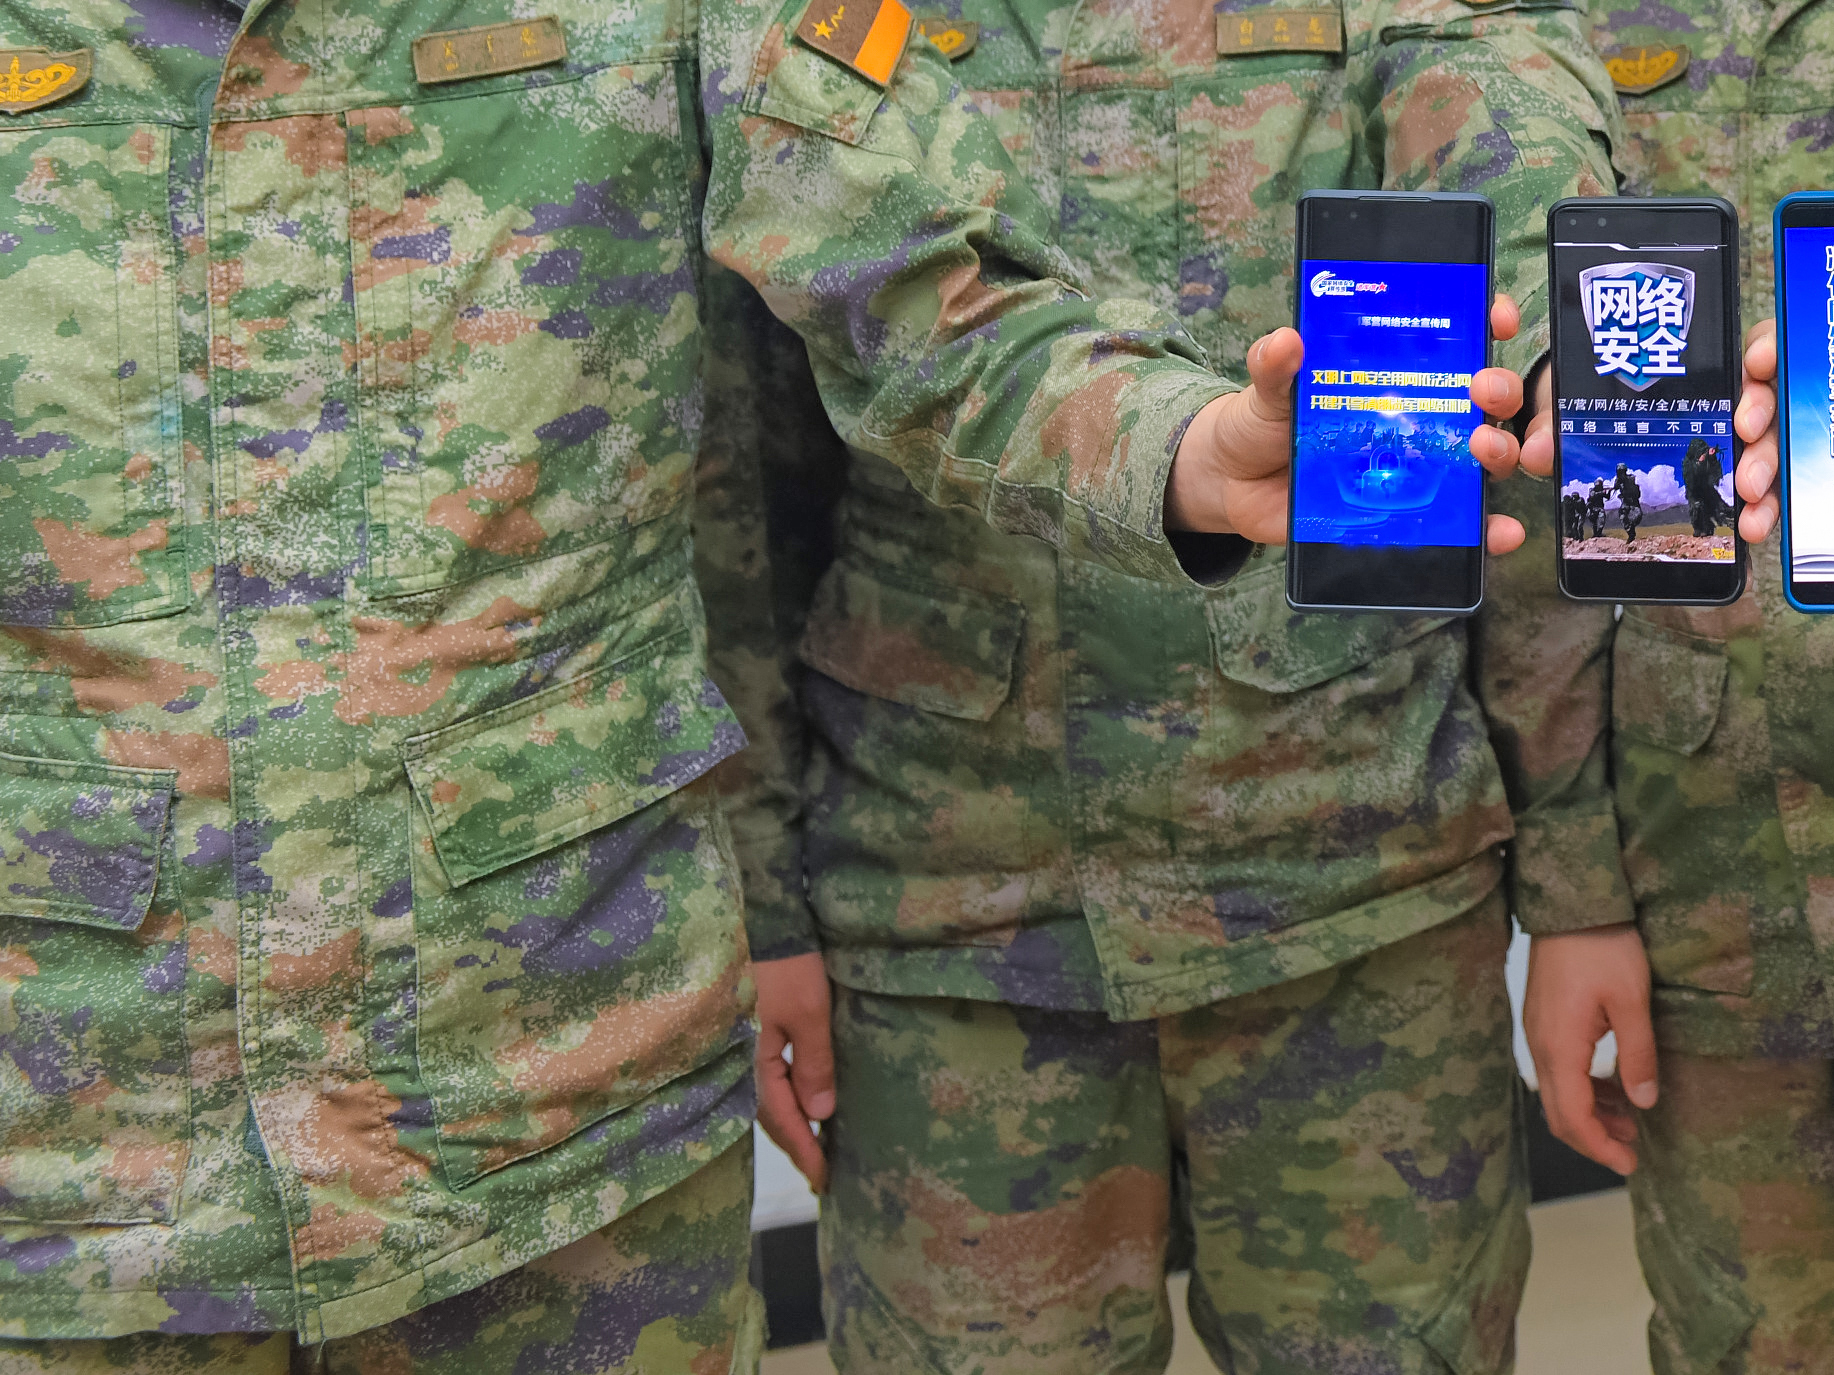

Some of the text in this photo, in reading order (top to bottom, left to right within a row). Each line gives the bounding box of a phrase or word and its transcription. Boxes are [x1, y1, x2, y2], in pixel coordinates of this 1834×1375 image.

[1592, 277, 1685, 326] 网络
[1593, 326, 1687, 375] 安全
[1311, 370, 1472, 388] 文明上网安全用网依法治网
